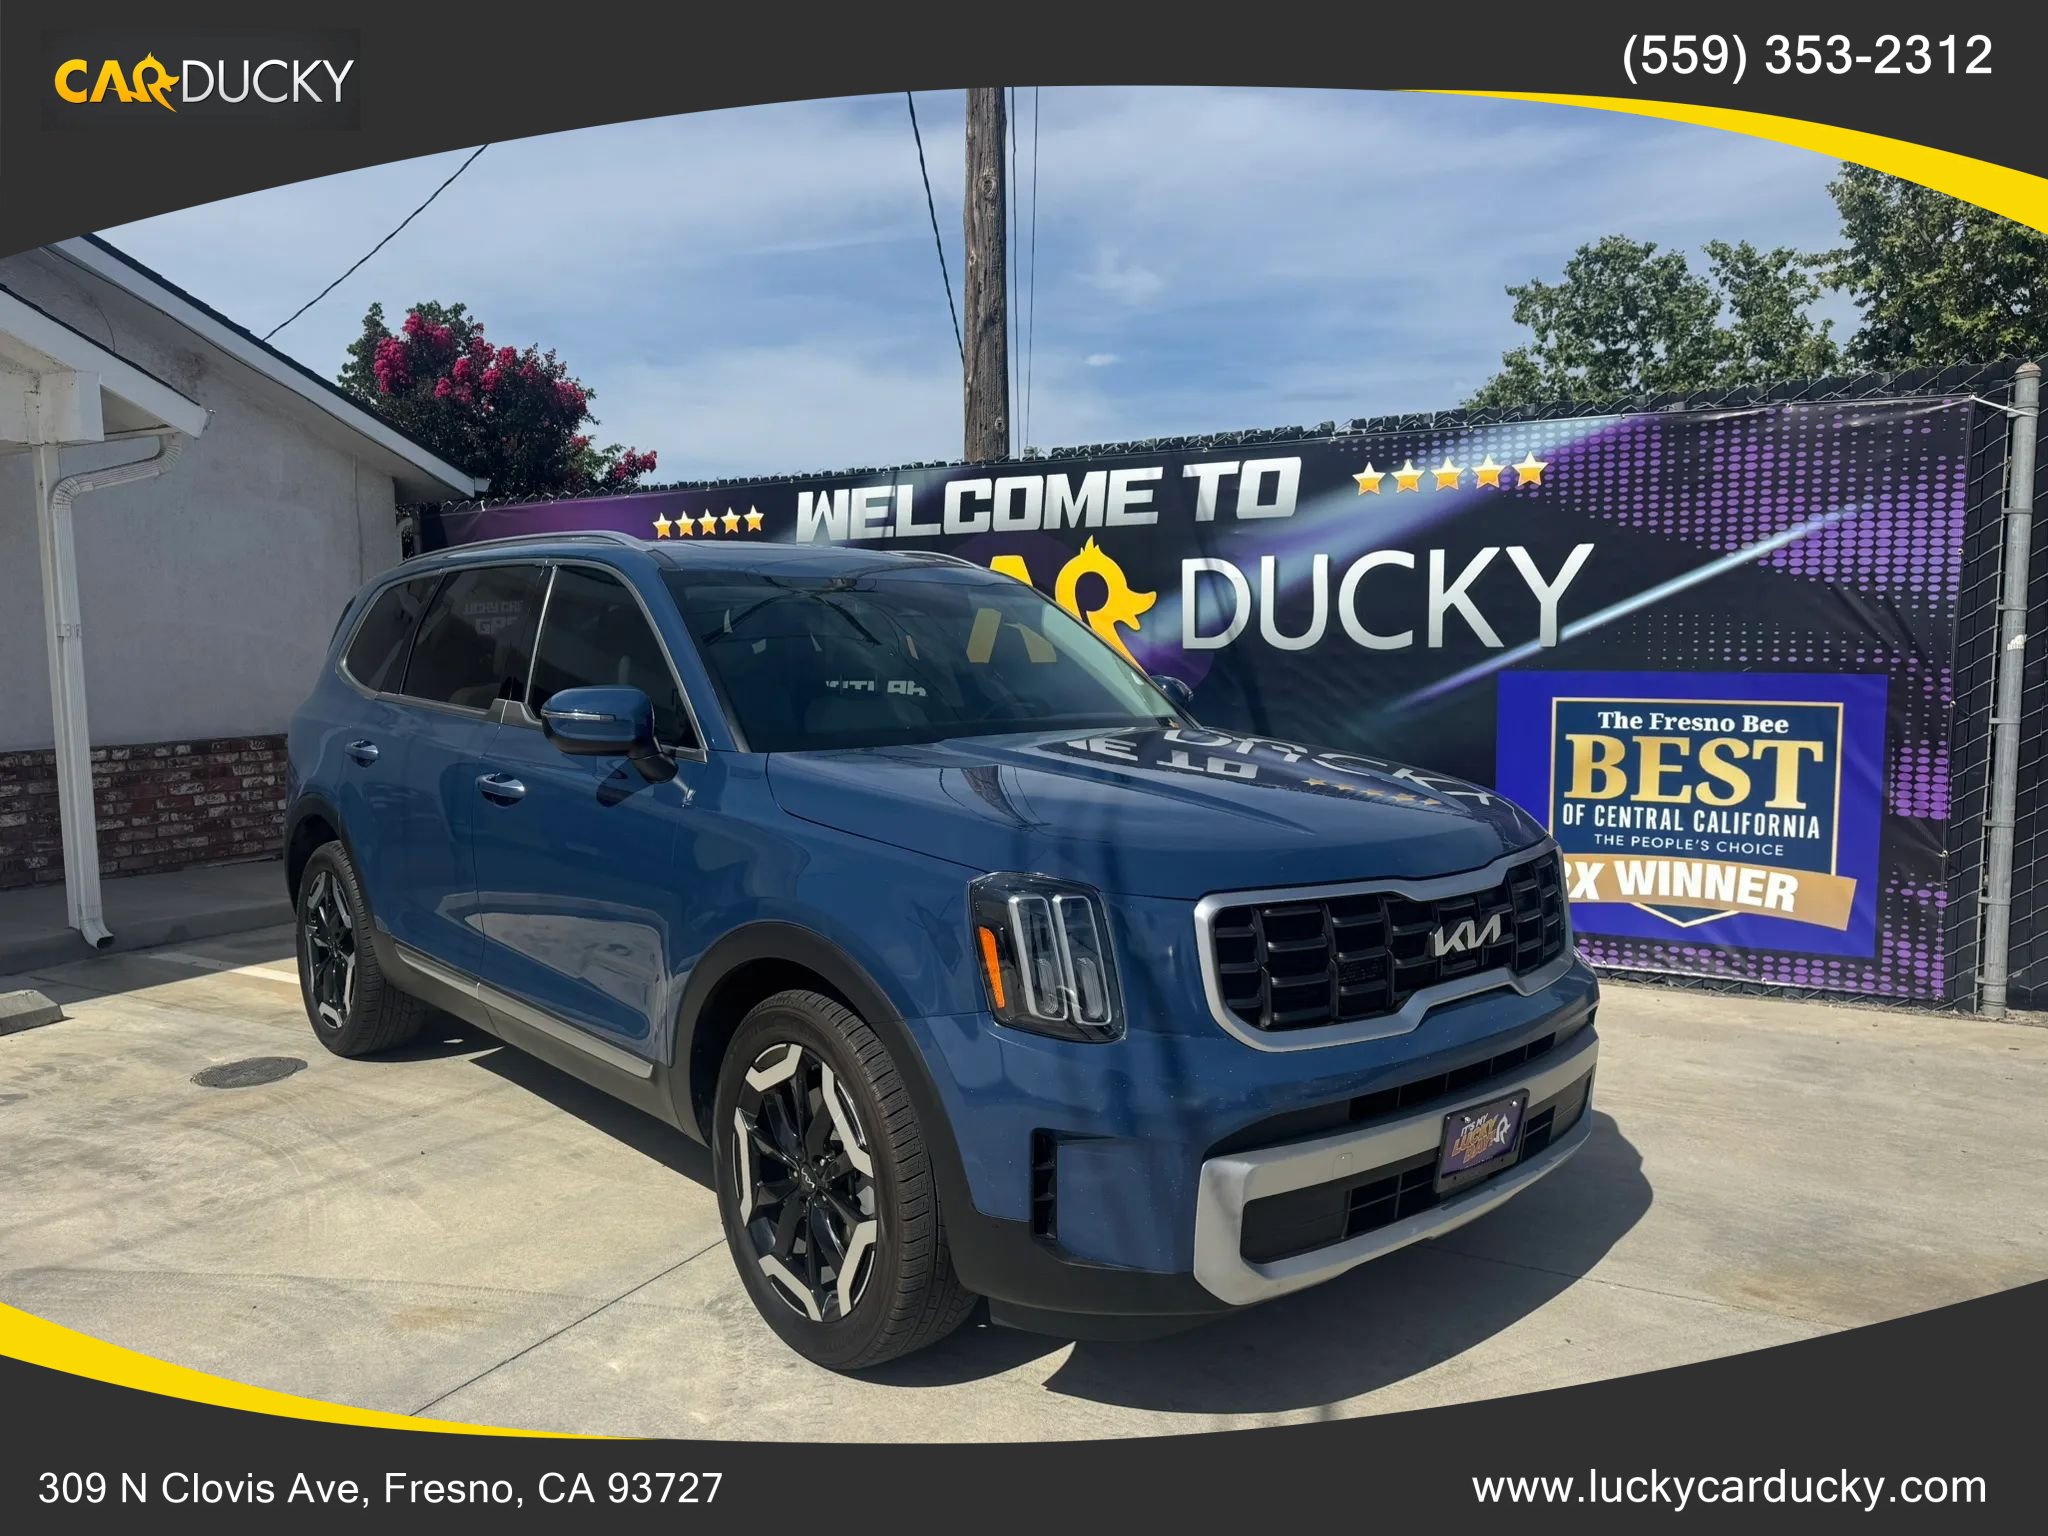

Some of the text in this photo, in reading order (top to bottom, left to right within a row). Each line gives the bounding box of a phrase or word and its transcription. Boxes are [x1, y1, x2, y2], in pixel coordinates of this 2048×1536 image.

[796, 456, 1302, 544] WELCOME TO
[1181, 543, 1595, 651] DUCKY
[1597, 711, 1790, 734] The Fresno Bee
[1563, 733, 1824, 810] BEST
[1562, 803, 1821, 840] OF CENTRAL CALIFORNIA
[1594, 833, 1785, 857] THE PEOPLE'S CHOICE
[1613, 860, 1800, 913] WINNER
[1430, 913, 1501, 957] KIA
